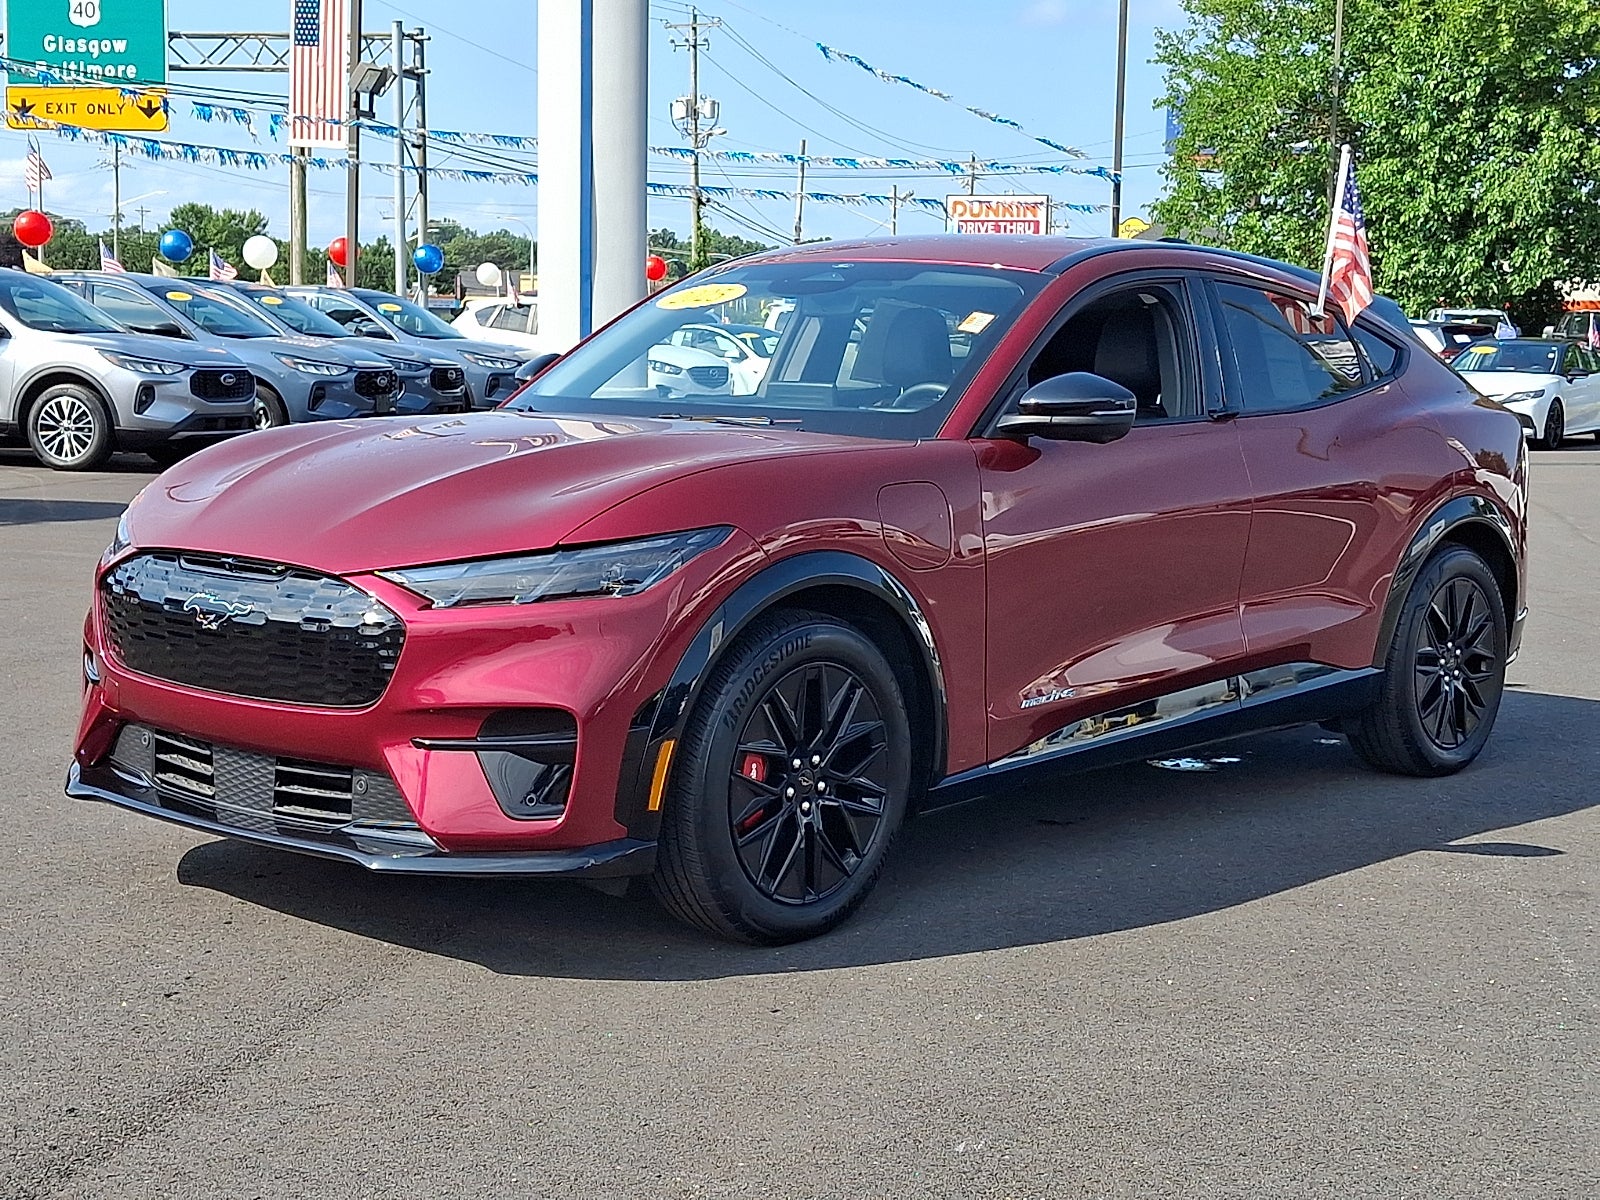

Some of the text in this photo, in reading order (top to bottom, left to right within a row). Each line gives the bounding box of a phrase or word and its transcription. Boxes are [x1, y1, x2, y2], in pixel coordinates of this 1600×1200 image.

[73, 1, 96, 18] 40
[43, 34, 128, 58] Glasgow
[35, 60, 137, 80] Baltimore
[46, 102, 126, 115] EXIT ONLY
[959, 221, 1034, 234] DRIVE THRU
[723, 632, 812, 731] BRIDGESTONE
